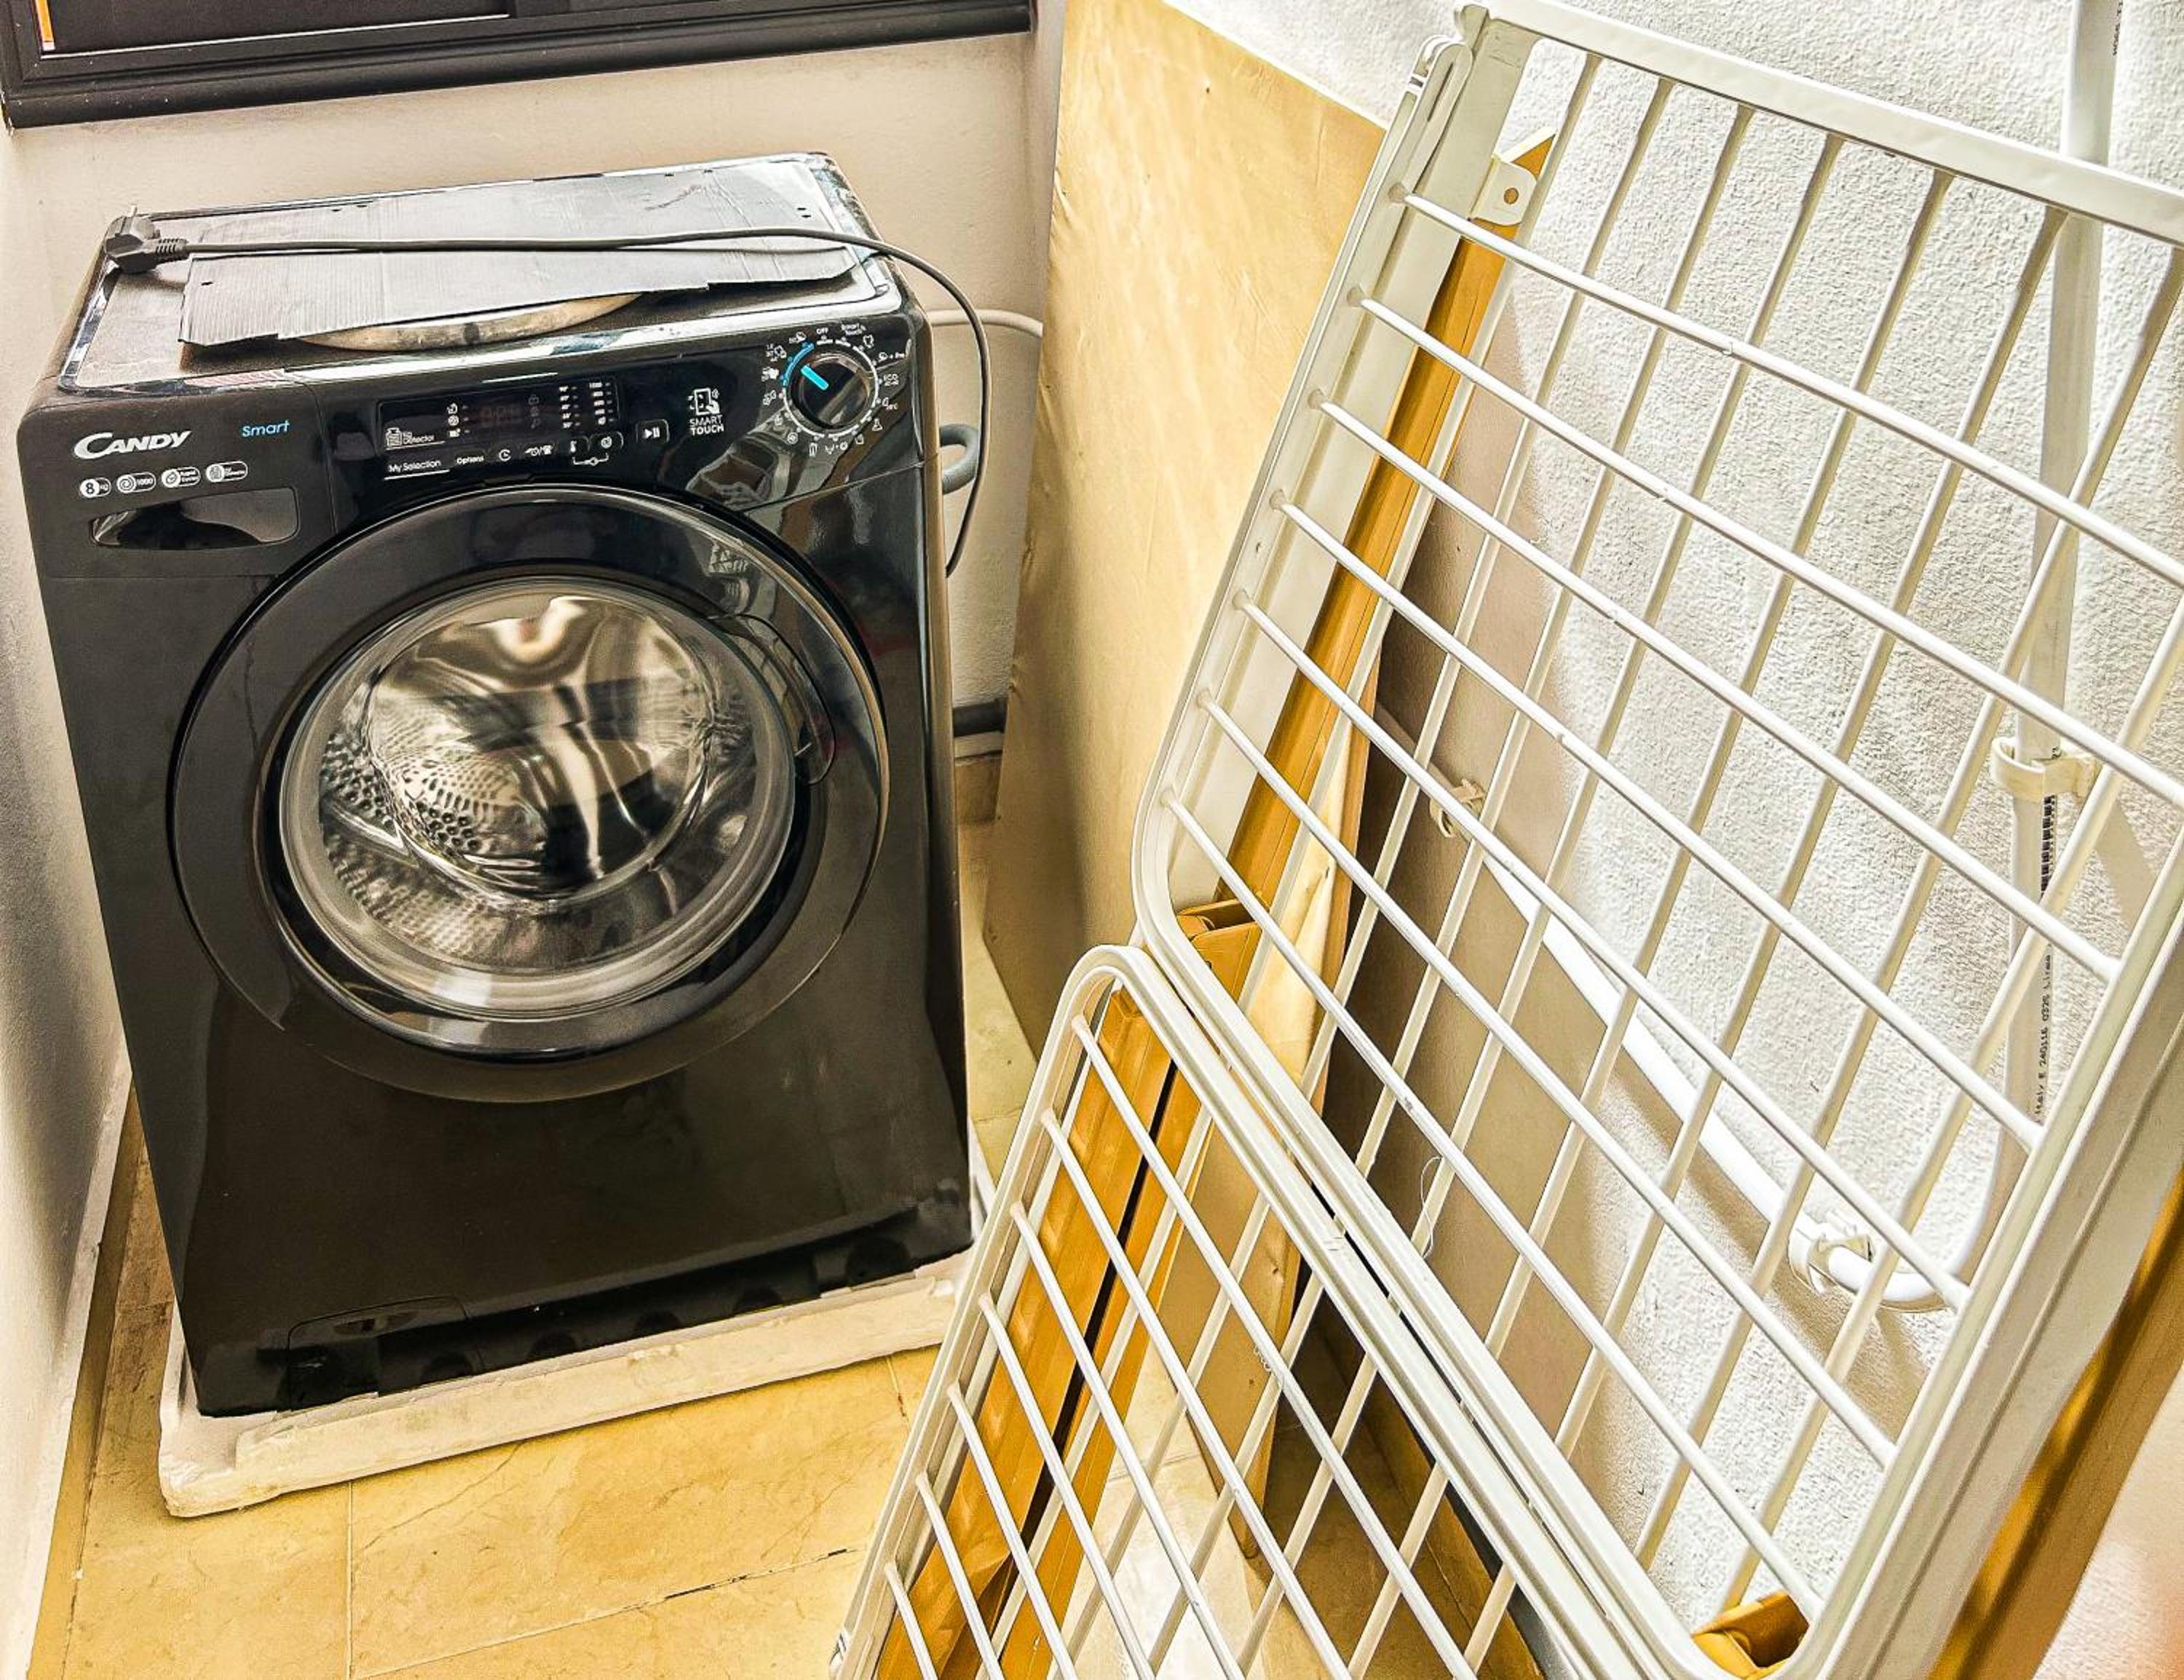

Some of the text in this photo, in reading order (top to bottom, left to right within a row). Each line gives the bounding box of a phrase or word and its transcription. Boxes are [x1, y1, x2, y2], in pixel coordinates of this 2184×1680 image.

[816, 327, 828, 335] OFF
[689, 414, 723, 427] SMART
[242, 420, 290, 437] Smart
[689, 424, 724, 436] TOUCH
[74, 430, 192, 459] CANDY
[456, 456, 484, 464] Options
[388, 460, 442, 473] My Selection
[85, 482, 95, 494] 8
